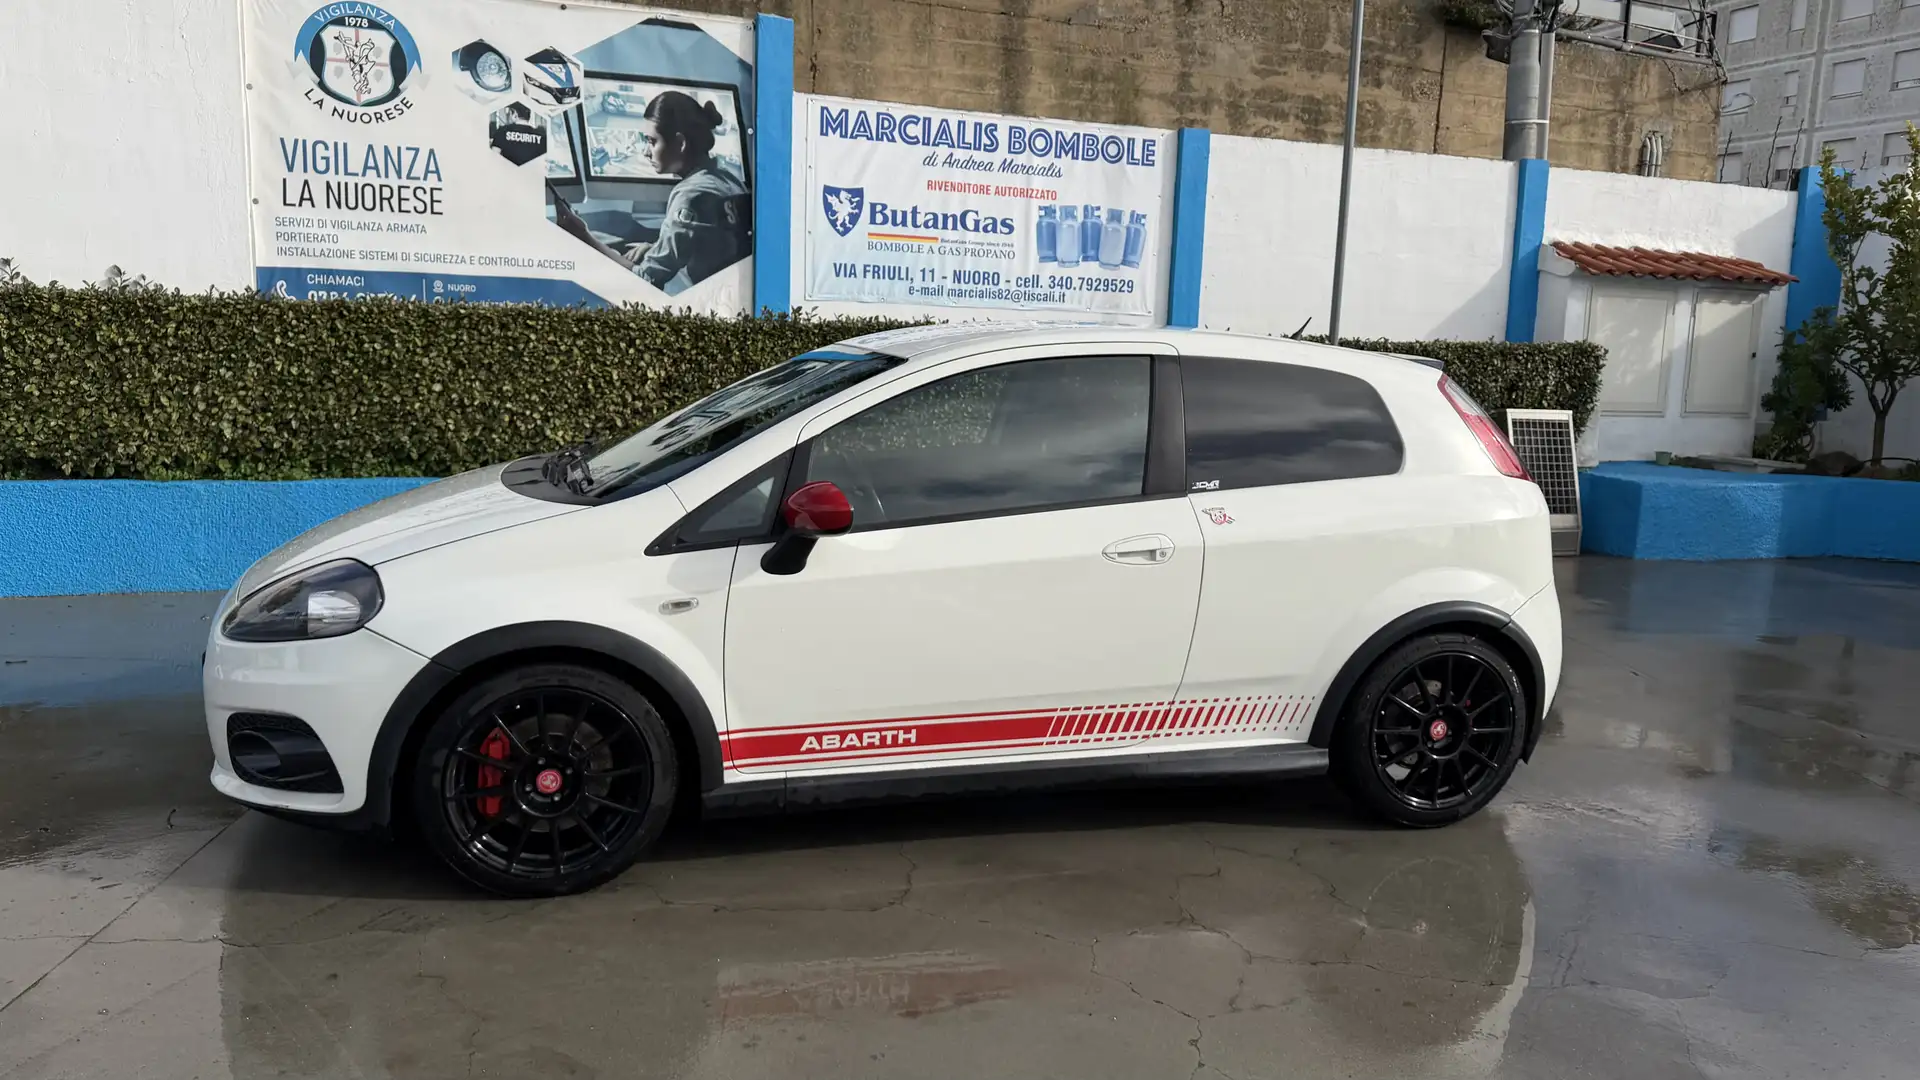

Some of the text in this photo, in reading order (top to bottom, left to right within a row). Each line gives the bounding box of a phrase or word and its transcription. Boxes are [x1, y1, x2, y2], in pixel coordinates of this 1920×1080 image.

[314, 3, 396, 30] VIGILANZA
[344, 16, 369, 28] 1978
[304, 88, 414, 124] LA NUORESE
[505, 131, 542, 145] SECURITY
[819, 105, 1156, 167] MARCIALIS BOMBOLE
[280, 137, 442, 182] VIGILANZA
[922, 151, 1063, 178] di Andrea Marcialis
[282, 177, 443, 215] LA NUORESE
[927, 180, 1057, 201] RIVENDITORE AUTORIZZATO
[275, 216, 427, 234] SERVIZI DI VIGILANZA ARMATA
[868, 201, 1015, 235] ButanGas
[276, 231, 339, 244] PORTIERATO
[277, 246, 575, 271] INSTALLAZIONE SISTEMI DI SICUREZZA E CONTROLLO ACCESSI
[867, 241, 1016, 260] BOMBOLE A GAS PROPANO
[307, 273, 364, 287] CHIAMACI
[447, 283, 477, 293] NUORO
[833, 263, 857, 279] VIA
[863, 264, 914, 283] FRIULI,
[920, 268, 935, 282] 11
[952, 270, 1000, 286] NUORO
[1016, 275, 1043, 289] cell.
[1049, 275, 1134, 293] 340.7929529
[908, 285, 1066, 303] e-mail marcialis82@tiscali.it
[800, 729, 917, 751] ABARTH
